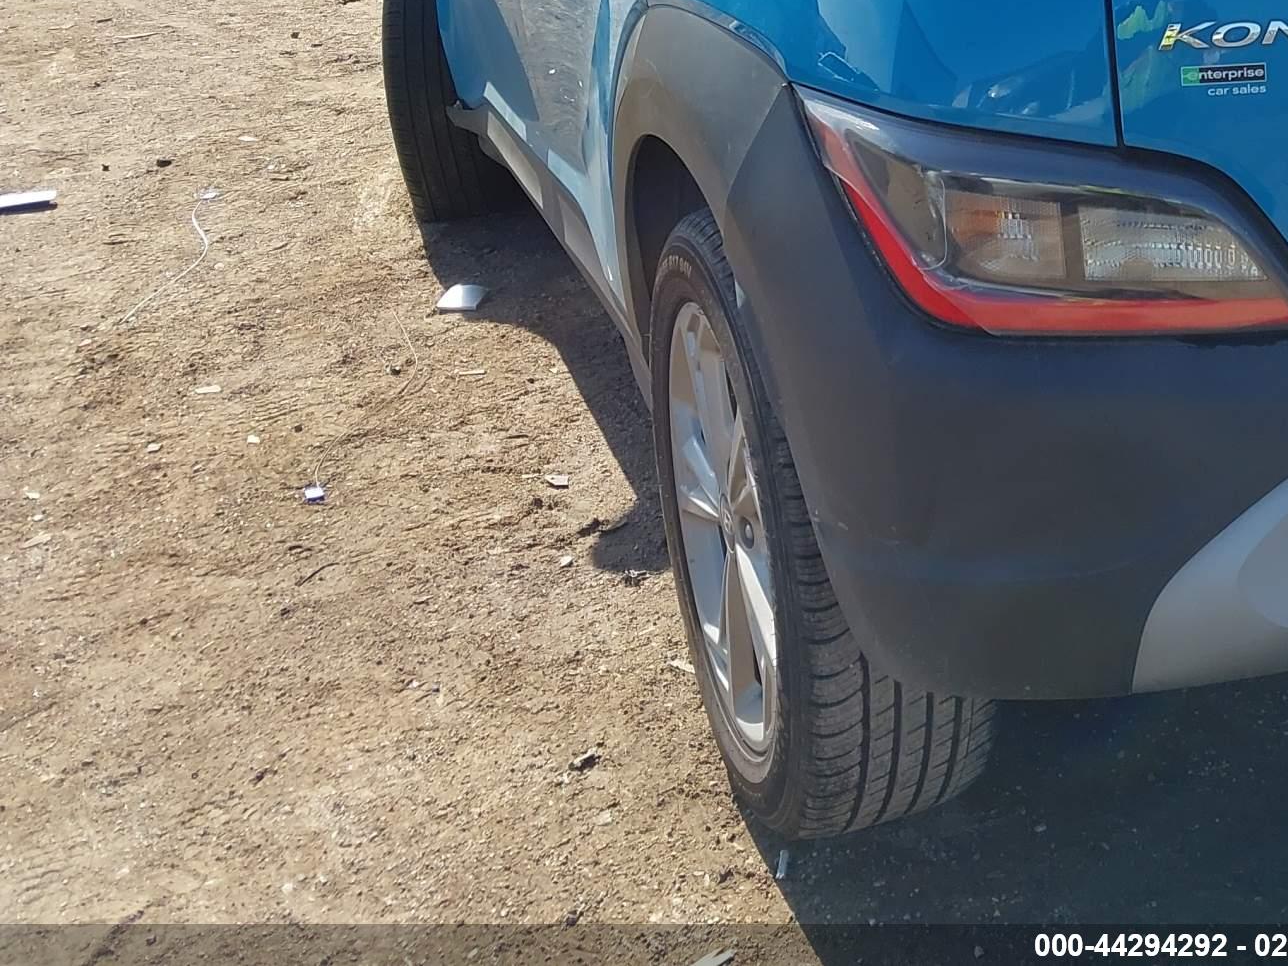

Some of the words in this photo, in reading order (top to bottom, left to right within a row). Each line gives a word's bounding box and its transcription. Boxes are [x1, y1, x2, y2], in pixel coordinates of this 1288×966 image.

[1185, 65, 1265, 83] enterprise
[1207, 86, 1230, 97] car
[1232, 83, 1267, 96] sales
